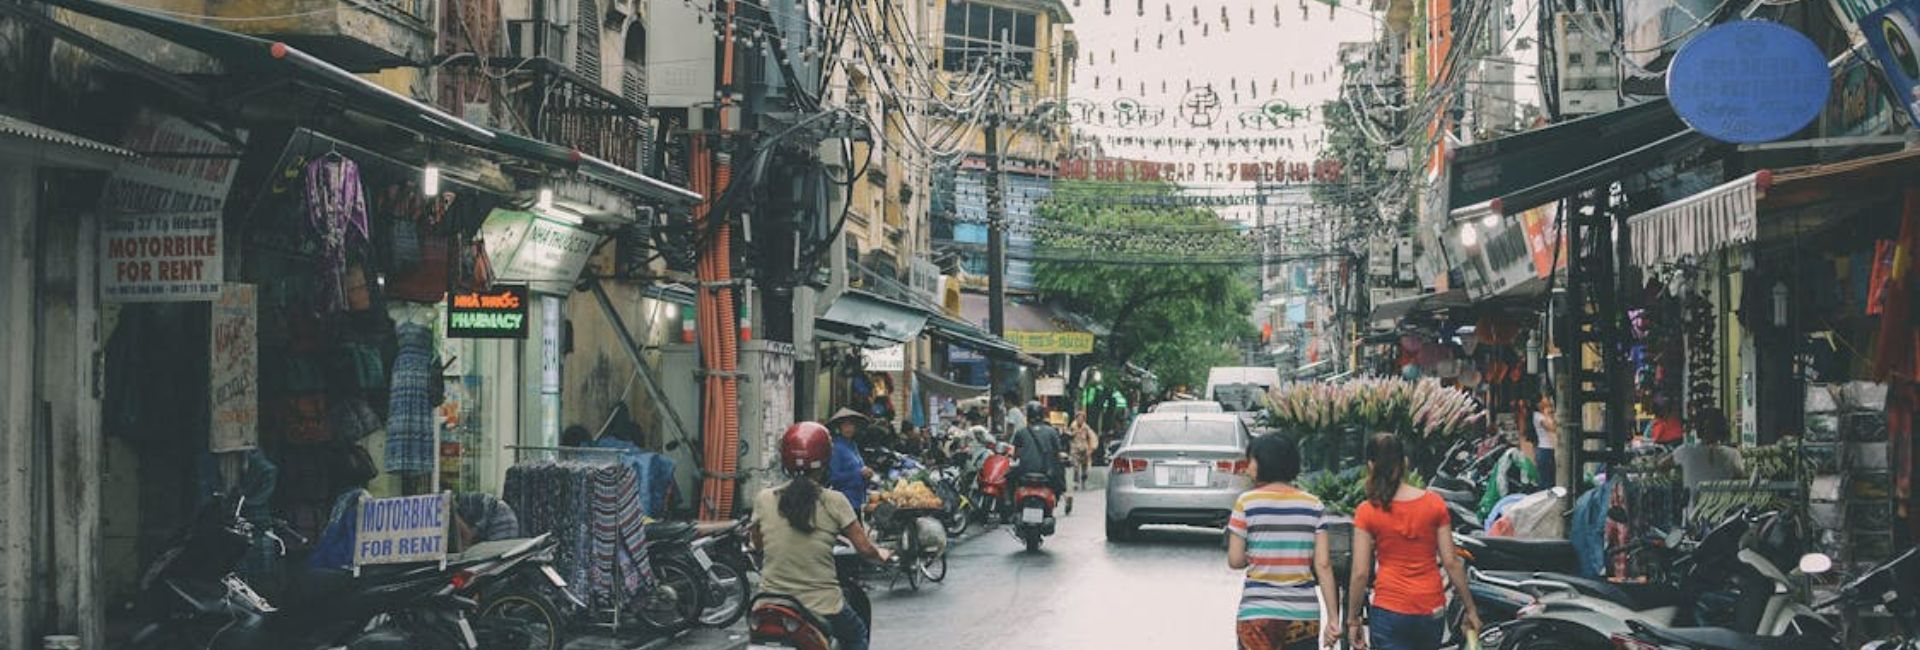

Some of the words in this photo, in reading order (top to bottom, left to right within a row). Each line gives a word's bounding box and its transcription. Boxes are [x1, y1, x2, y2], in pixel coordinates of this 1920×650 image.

[108, 234, 217, 260] MOTORBIKE
[116, 260, 152, 283] FOR
[158, 259, 204, 281] RENT
[451, 312, 523, 330] PHARMACY
[362, 496, 443, 533] MOTORBIKE
[361, 540, 393, 558] FOR
[399, 535, 442, 555] RENT
